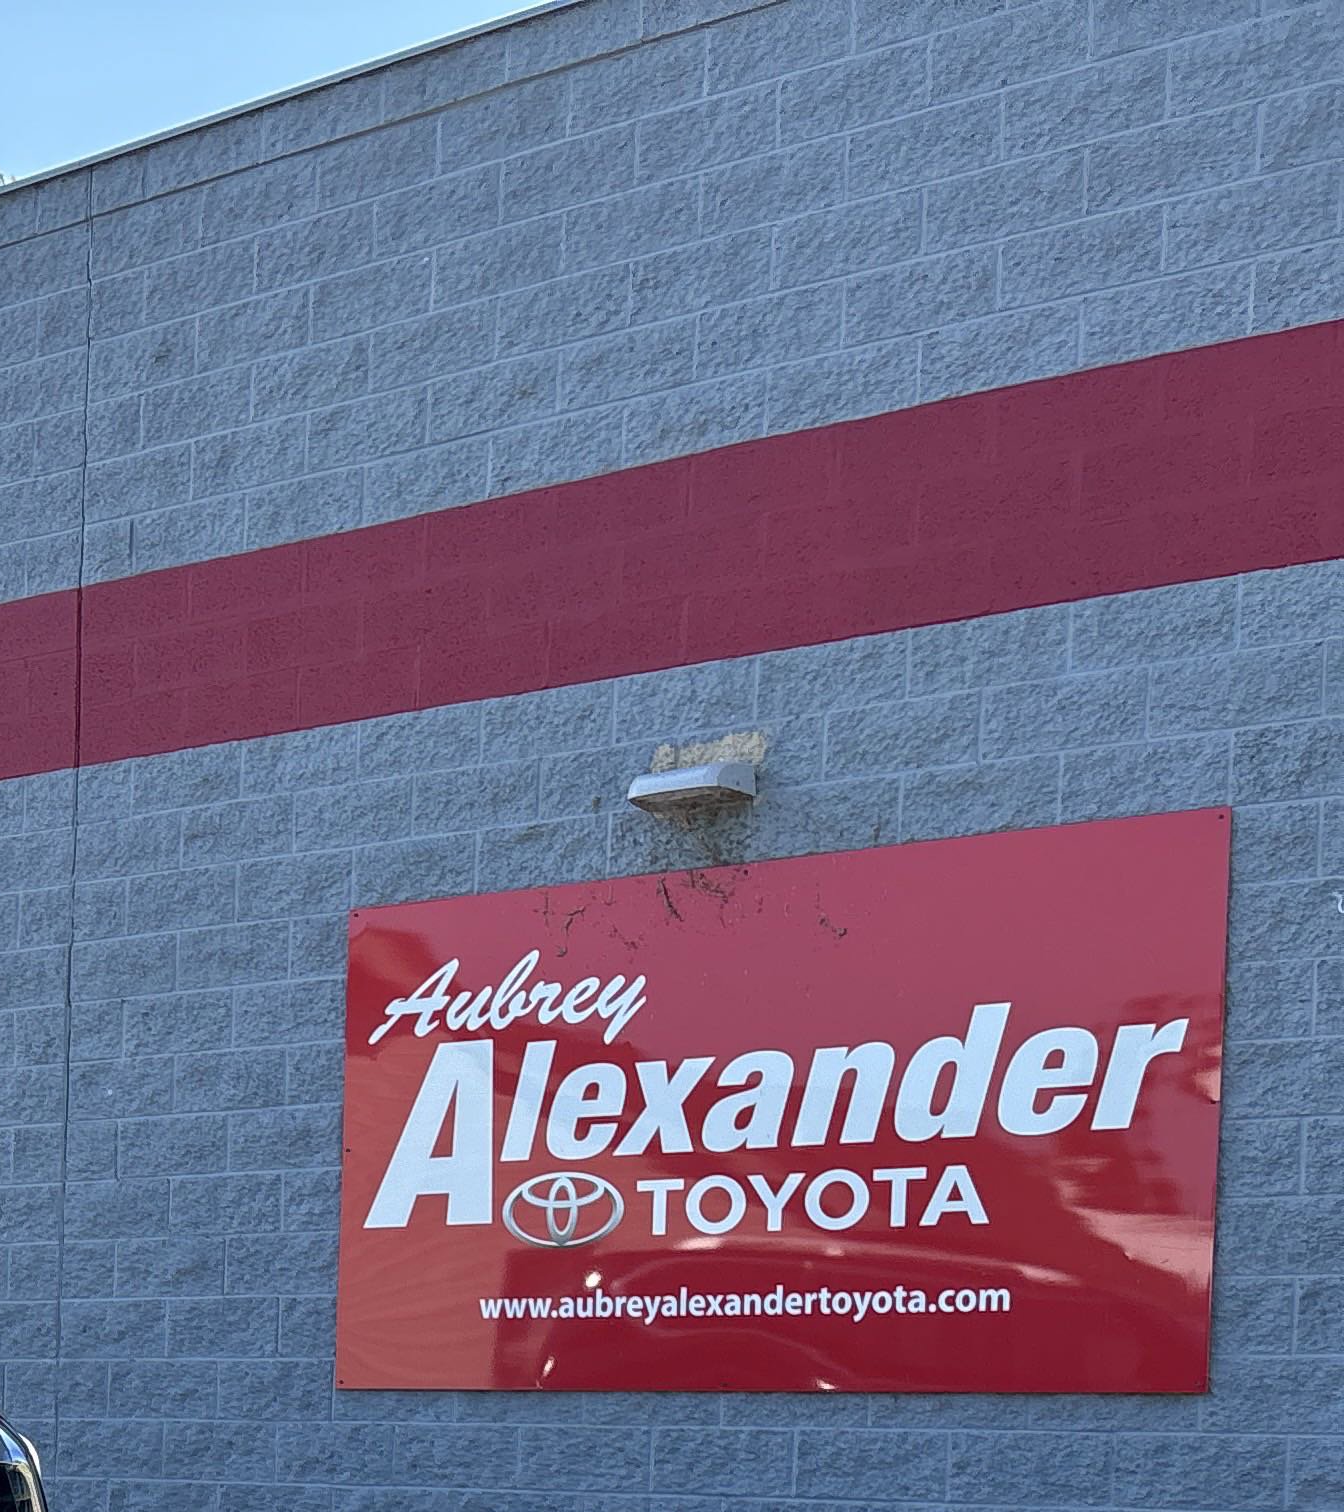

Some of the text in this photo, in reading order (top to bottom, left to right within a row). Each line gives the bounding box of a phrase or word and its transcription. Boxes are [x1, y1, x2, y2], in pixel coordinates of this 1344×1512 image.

[368, 948, 647, 1045] Aubrey
[362, 1001, 1190, 1229] Alexander
[636, 1164, 990, 1236] TOYOTA
[478, 1283, 1011, 1325] www.aubreyalexandertoyota.com
